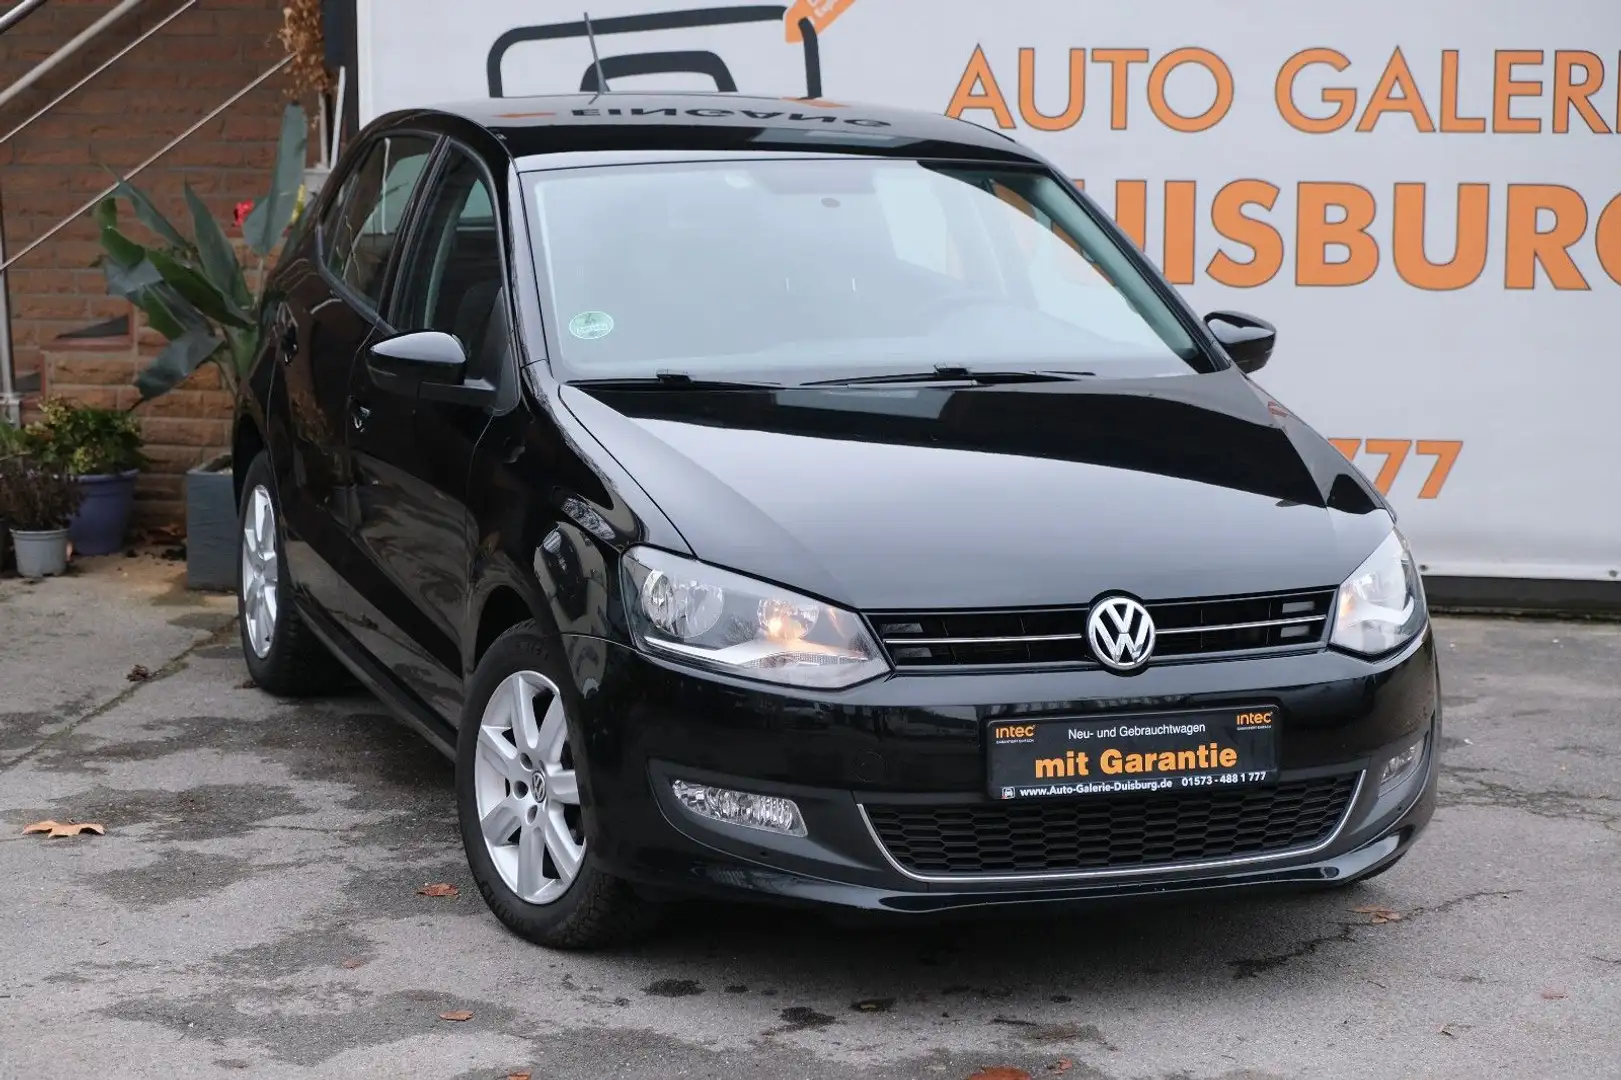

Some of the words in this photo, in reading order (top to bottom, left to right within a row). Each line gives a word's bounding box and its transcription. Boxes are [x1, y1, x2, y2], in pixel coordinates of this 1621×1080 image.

[944, 43, 1235, 133] AUTO
[1275, 46, 1621, 134] GALER
[1068, 728, 1094, 740] Neu-
[1096, 726, 1117, 739] und
[1119, 723, 1206, 737] Gebrauchtwagen
[1035, 751, 1089, 778] mit
[1100, 742, 1238, 775] Garantie
[1020, 778, 1173, 797] www.Auto-Galerie-Duisburg.de
[1181, 776, 1213, 787] 01573
